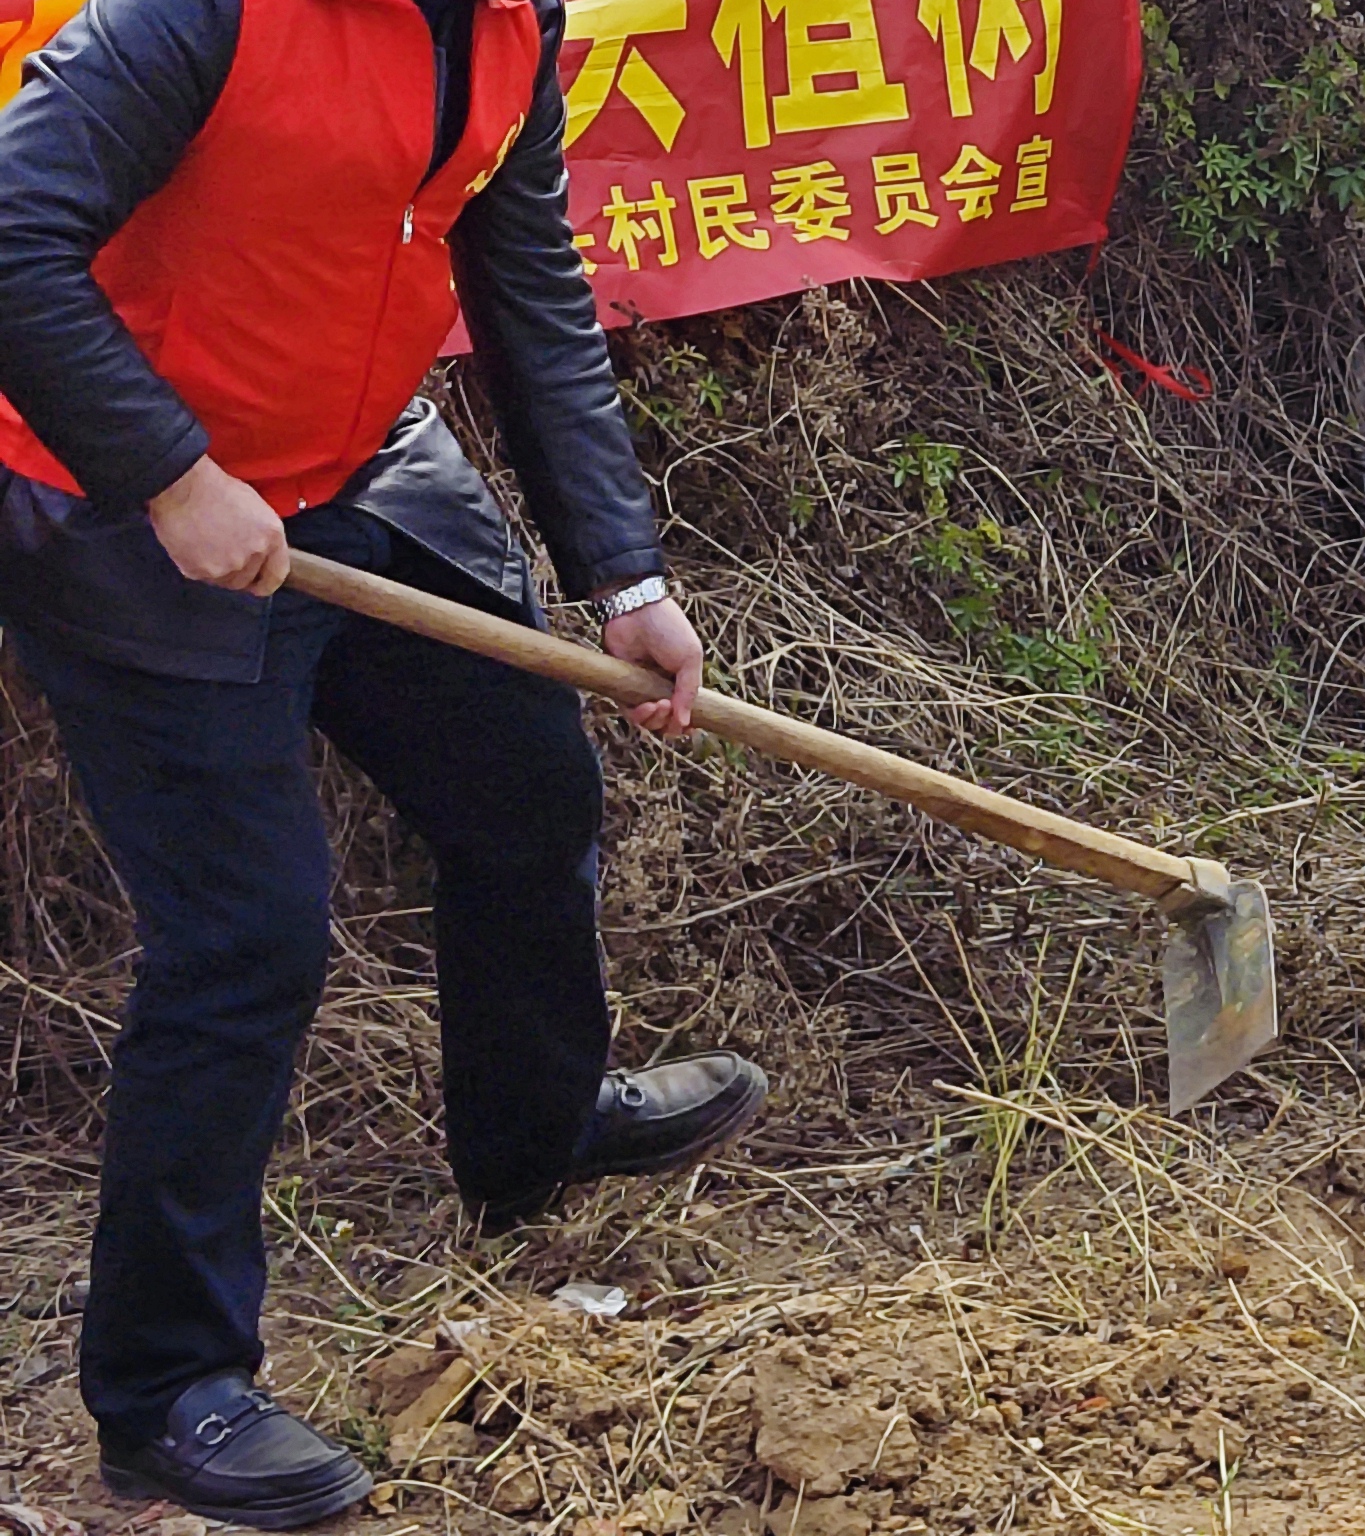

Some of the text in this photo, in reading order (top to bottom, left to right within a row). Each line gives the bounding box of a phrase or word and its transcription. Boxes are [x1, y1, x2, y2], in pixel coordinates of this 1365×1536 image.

[571, 133, 1053, 276] 村民委员会宣
